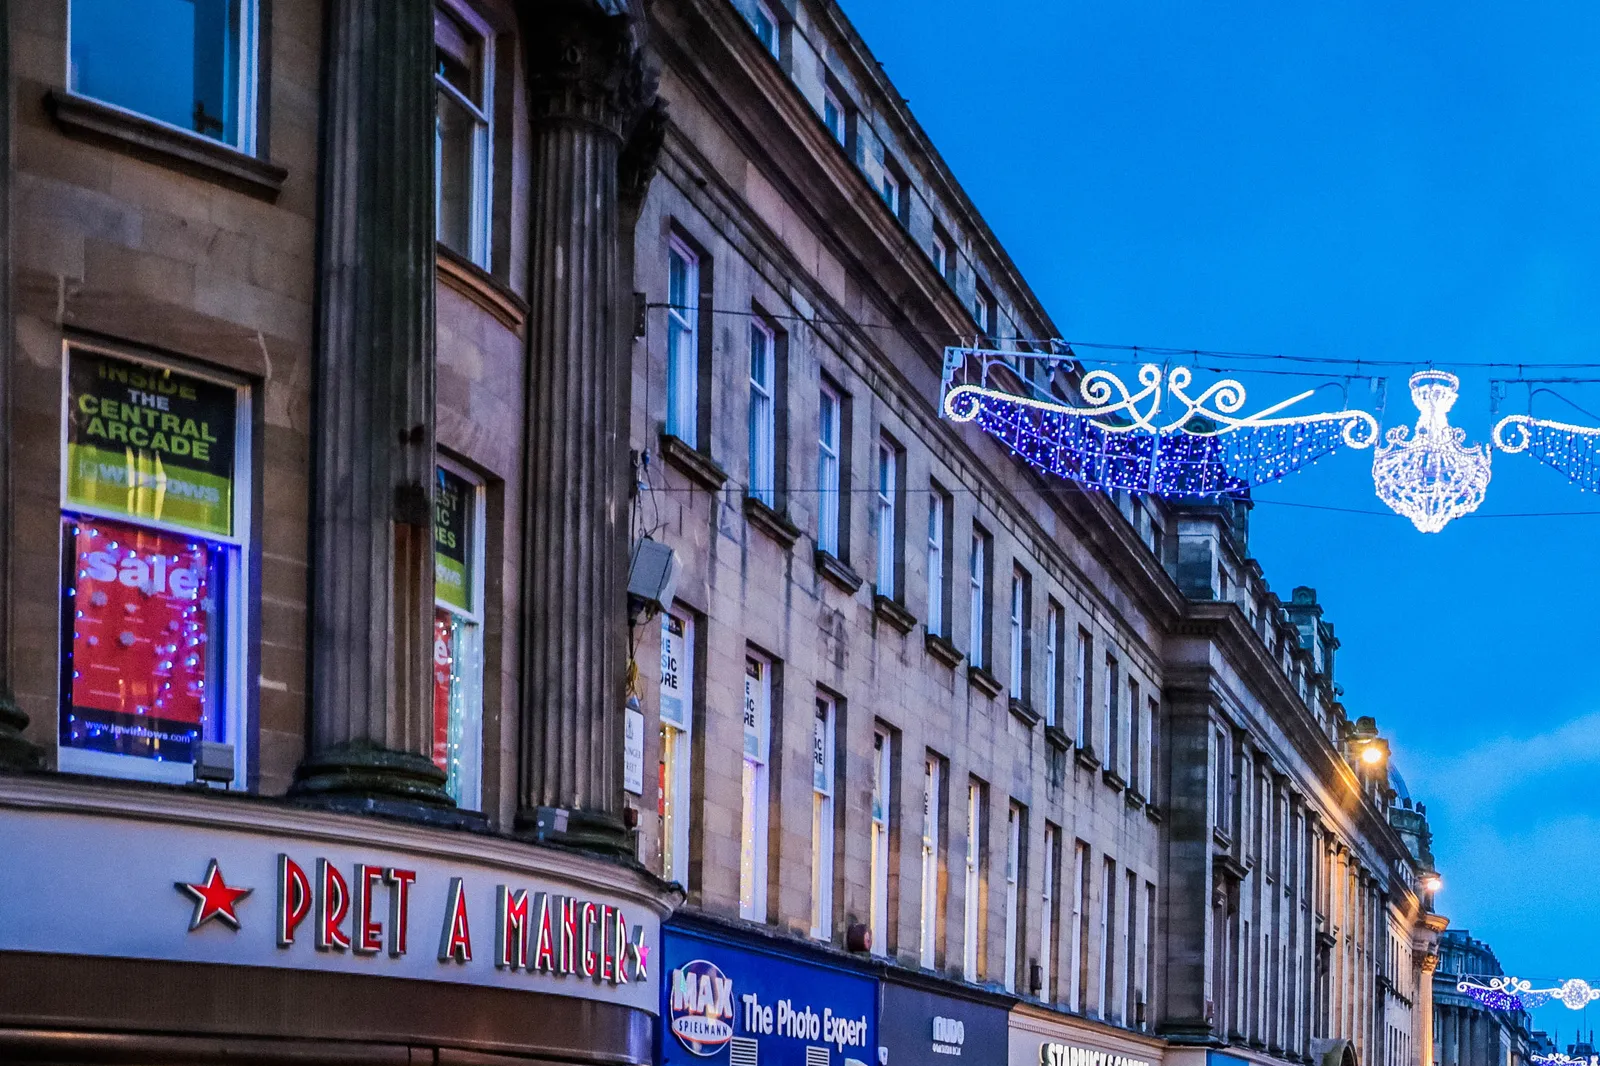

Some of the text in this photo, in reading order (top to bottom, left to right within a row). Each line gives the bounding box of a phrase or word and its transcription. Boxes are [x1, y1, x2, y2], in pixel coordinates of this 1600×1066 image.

[99, 364, 197, 401] INSIDE
[127, 389, 170, 412] THE
[79, 394, 217, 444] CENTRAL
[87, 417, 210, 462] ARCADE
[86, 551, 199, 599] sale
[278, 853, 628, 985] PRET A MANGER
[673, 968, 733, 1019] MAX
[678, 1019, 728, 1037] SPIELMANN
[743, 993, 867, 1053] The Photo Expert
